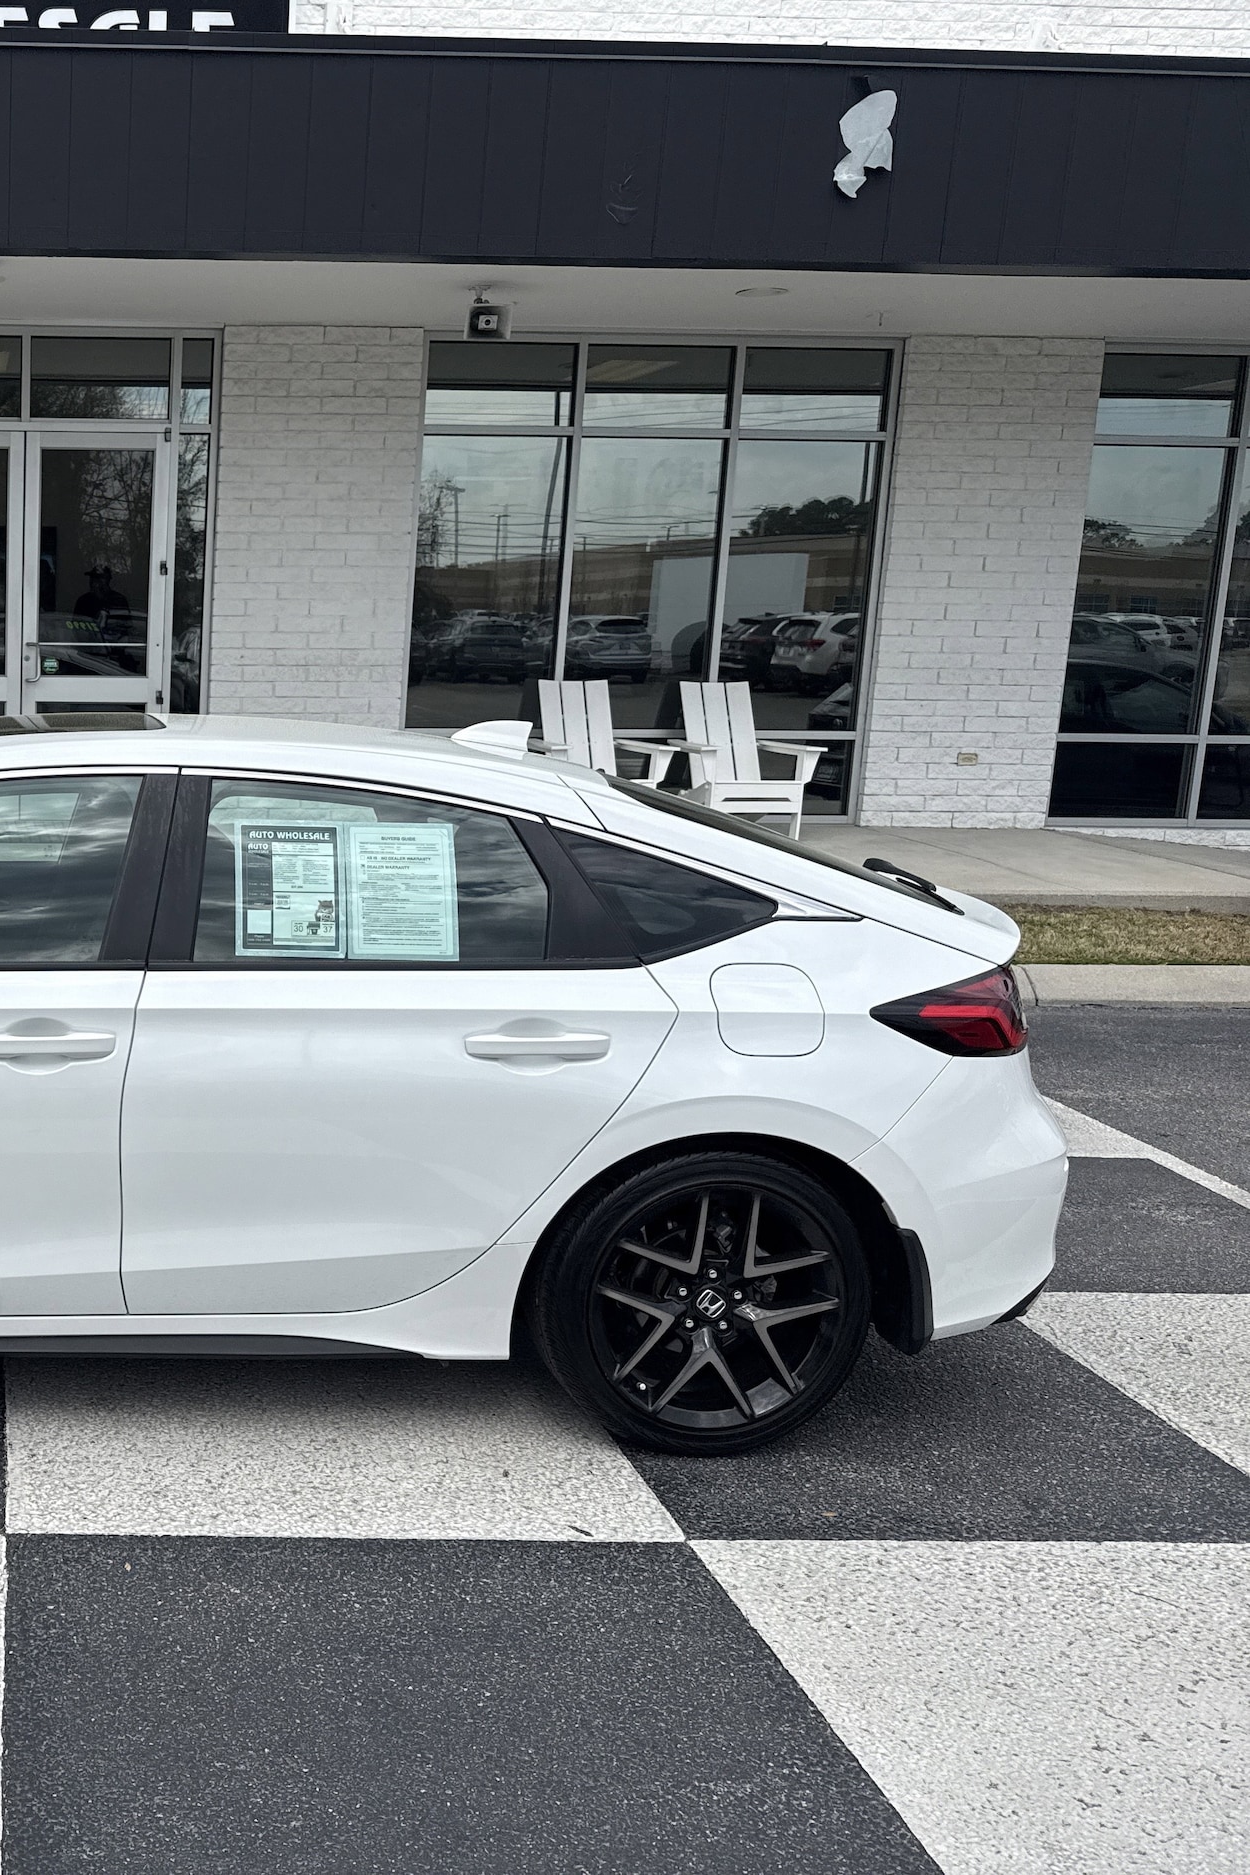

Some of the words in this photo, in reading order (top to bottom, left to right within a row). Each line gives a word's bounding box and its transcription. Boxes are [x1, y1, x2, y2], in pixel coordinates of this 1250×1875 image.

[249, 830, 274, 839] AUTO
[276, 831, 330, 841] WHOLESALE
[293, 924, 304, 933] 30
[323, 925, 333, 934] 37
